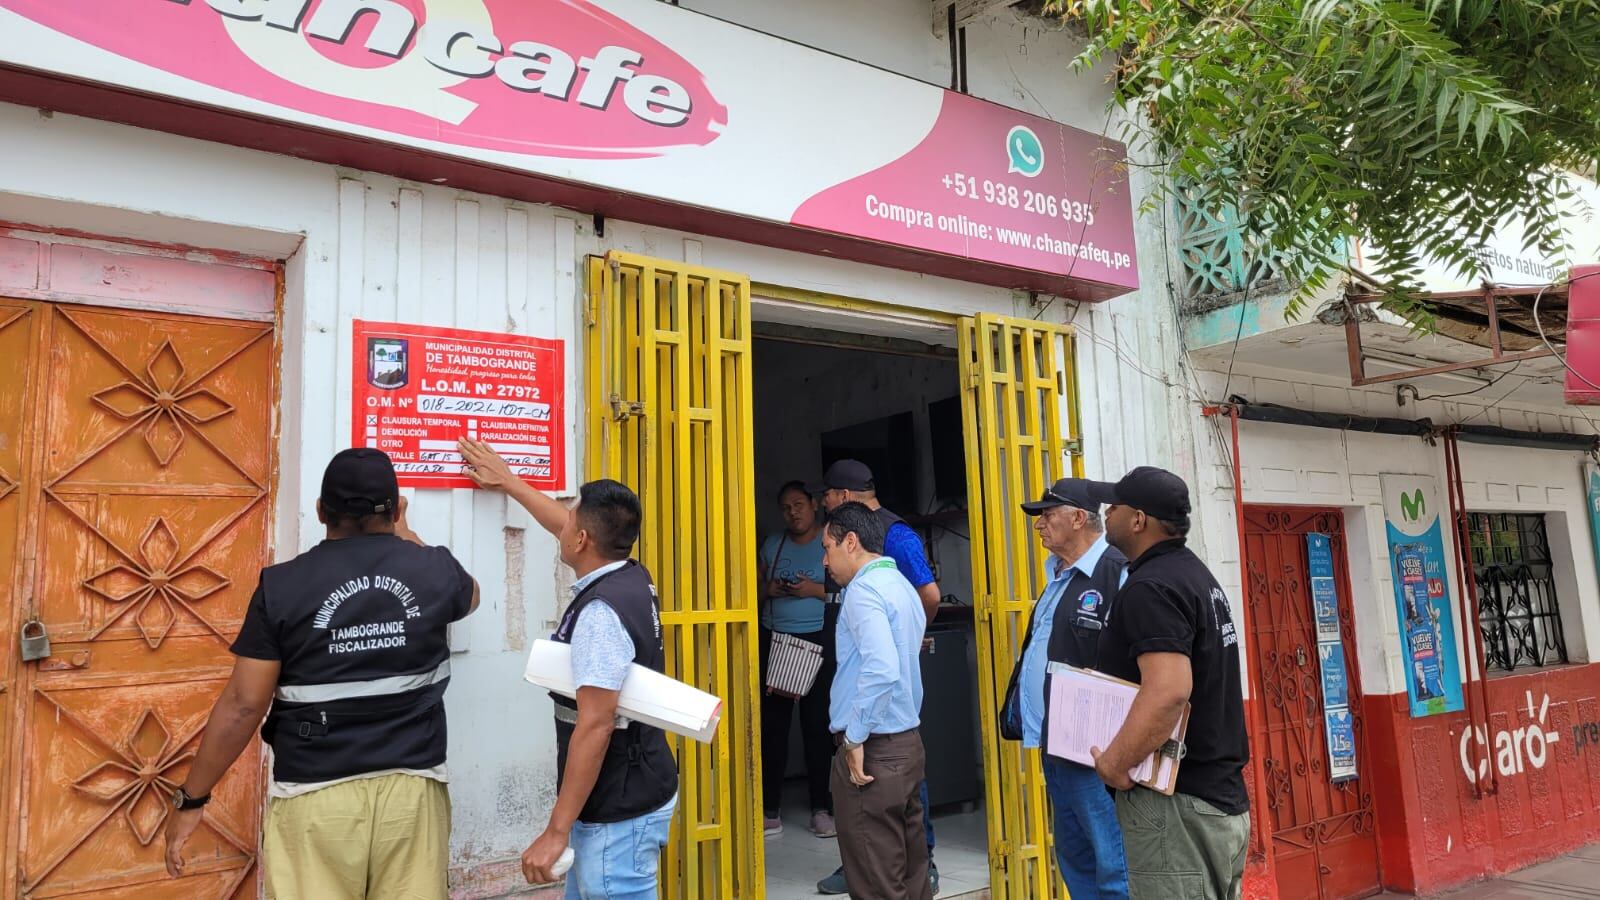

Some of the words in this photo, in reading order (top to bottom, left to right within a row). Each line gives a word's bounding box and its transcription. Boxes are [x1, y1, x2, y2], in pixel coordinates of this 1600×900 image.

[942, 172, 979, 200] +51
[983, 179, 1020, 208] 938
[1023, 189, 1058, 217] 206
[1062, 198, 1095, 225] 935
[865, 194, 933, 228] Compra
[938, 214, 993, 241] online:
[996, 226, 1131, 270] www.chancafeq.pe
[425, 342, 494, 355] MUNICIPALIDAD
[496, 348, 536, 359] DISTRITAL
[426, 352, 443, 363] DE
[446, 354, 537, 371] TAMBOGRANDE
[421, 378, 471, 394] L.O.M.
[497, 384, 540, 399] 27972
[366, 396, 395, 407] O.M.
[381, 416, 422, 425] CLAUSURA
[423, 418, 462, 428] TEMPORAL
[481, 421, 517, 430] CLAUSURA
[518, 424, 549, 433] DEFINITIVA
[381, 427, 428, 437] DEMOLICIÓN
[480, 432, 528, 442] PARALIZACIÓN
[381, 440, 403, 448] OTRO
[387, 451, 415, 460] ETALLE
[313, 576, 370, 629] MUNICIPALIDAD
[374, 575, 415, 607] DISTRITAL
[405, 605, 421, 619] DE
[331, 621, 405, 641] TAMBOGRANDE
[328, 636, 406, 654] FISCALIZADOR
[1573, 721, 1600, 756] pre
